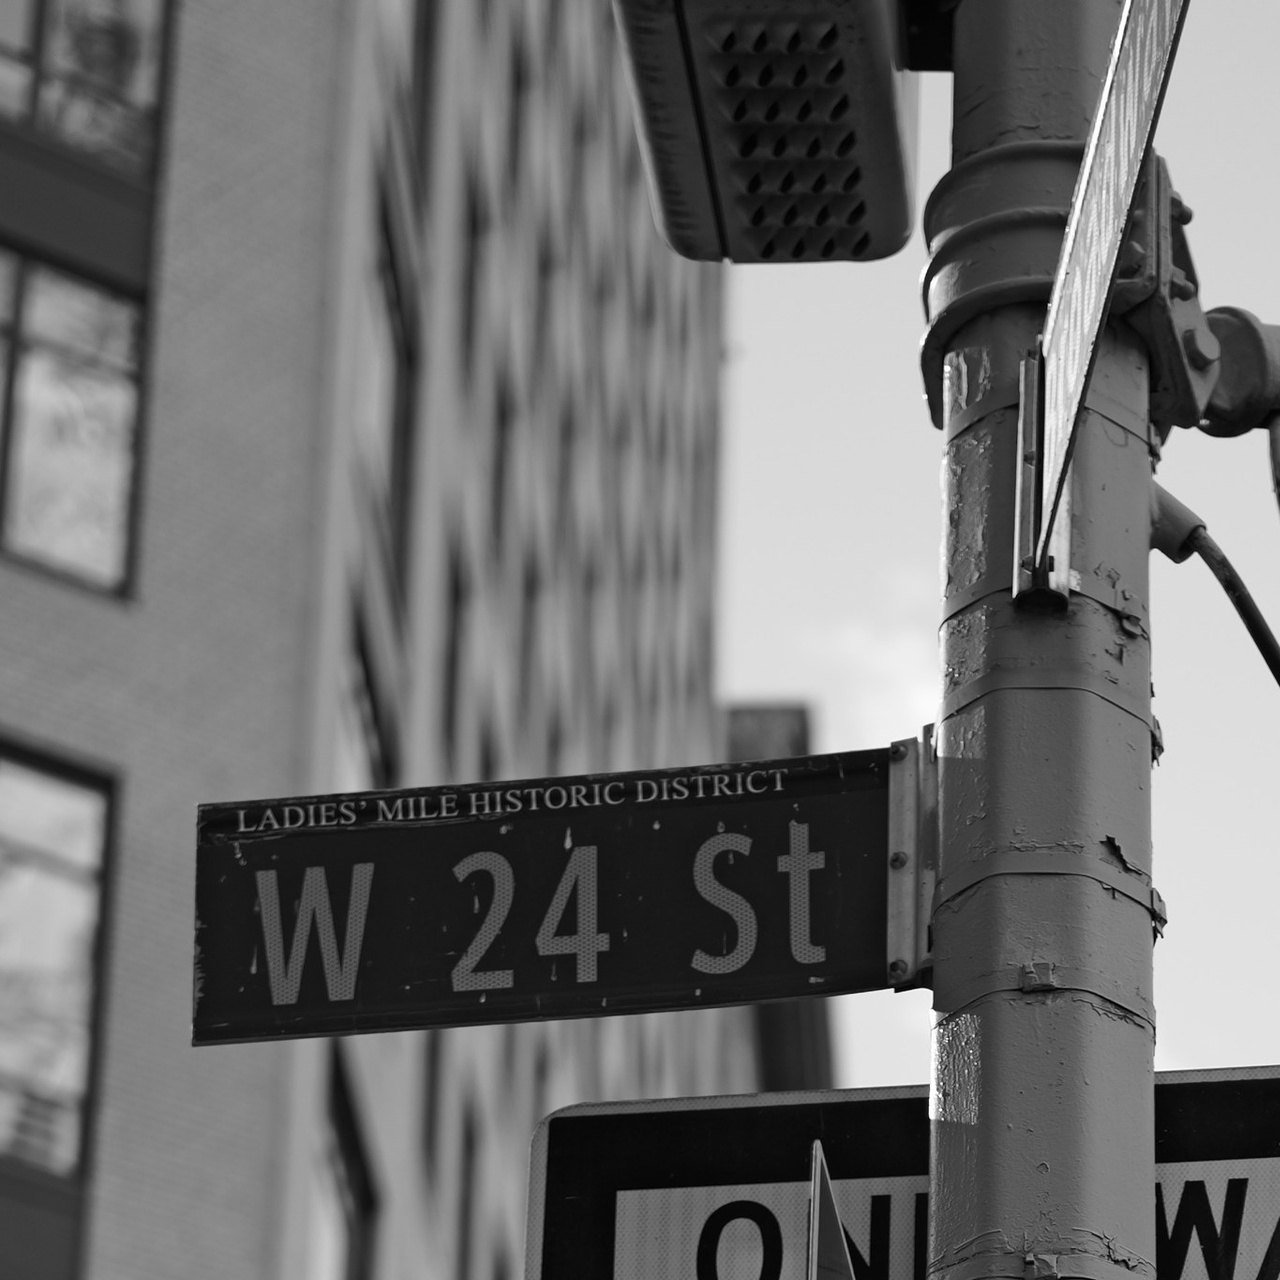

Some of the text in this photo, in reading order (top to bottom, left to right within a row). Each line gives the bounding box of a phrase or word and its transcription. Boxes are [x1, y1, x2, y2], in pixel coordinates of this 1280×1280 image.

[236, 768, 789, 833] LADIES' MILE HISTORIC DISTRICT
[255, 820, 826, 1006] W 24 St
